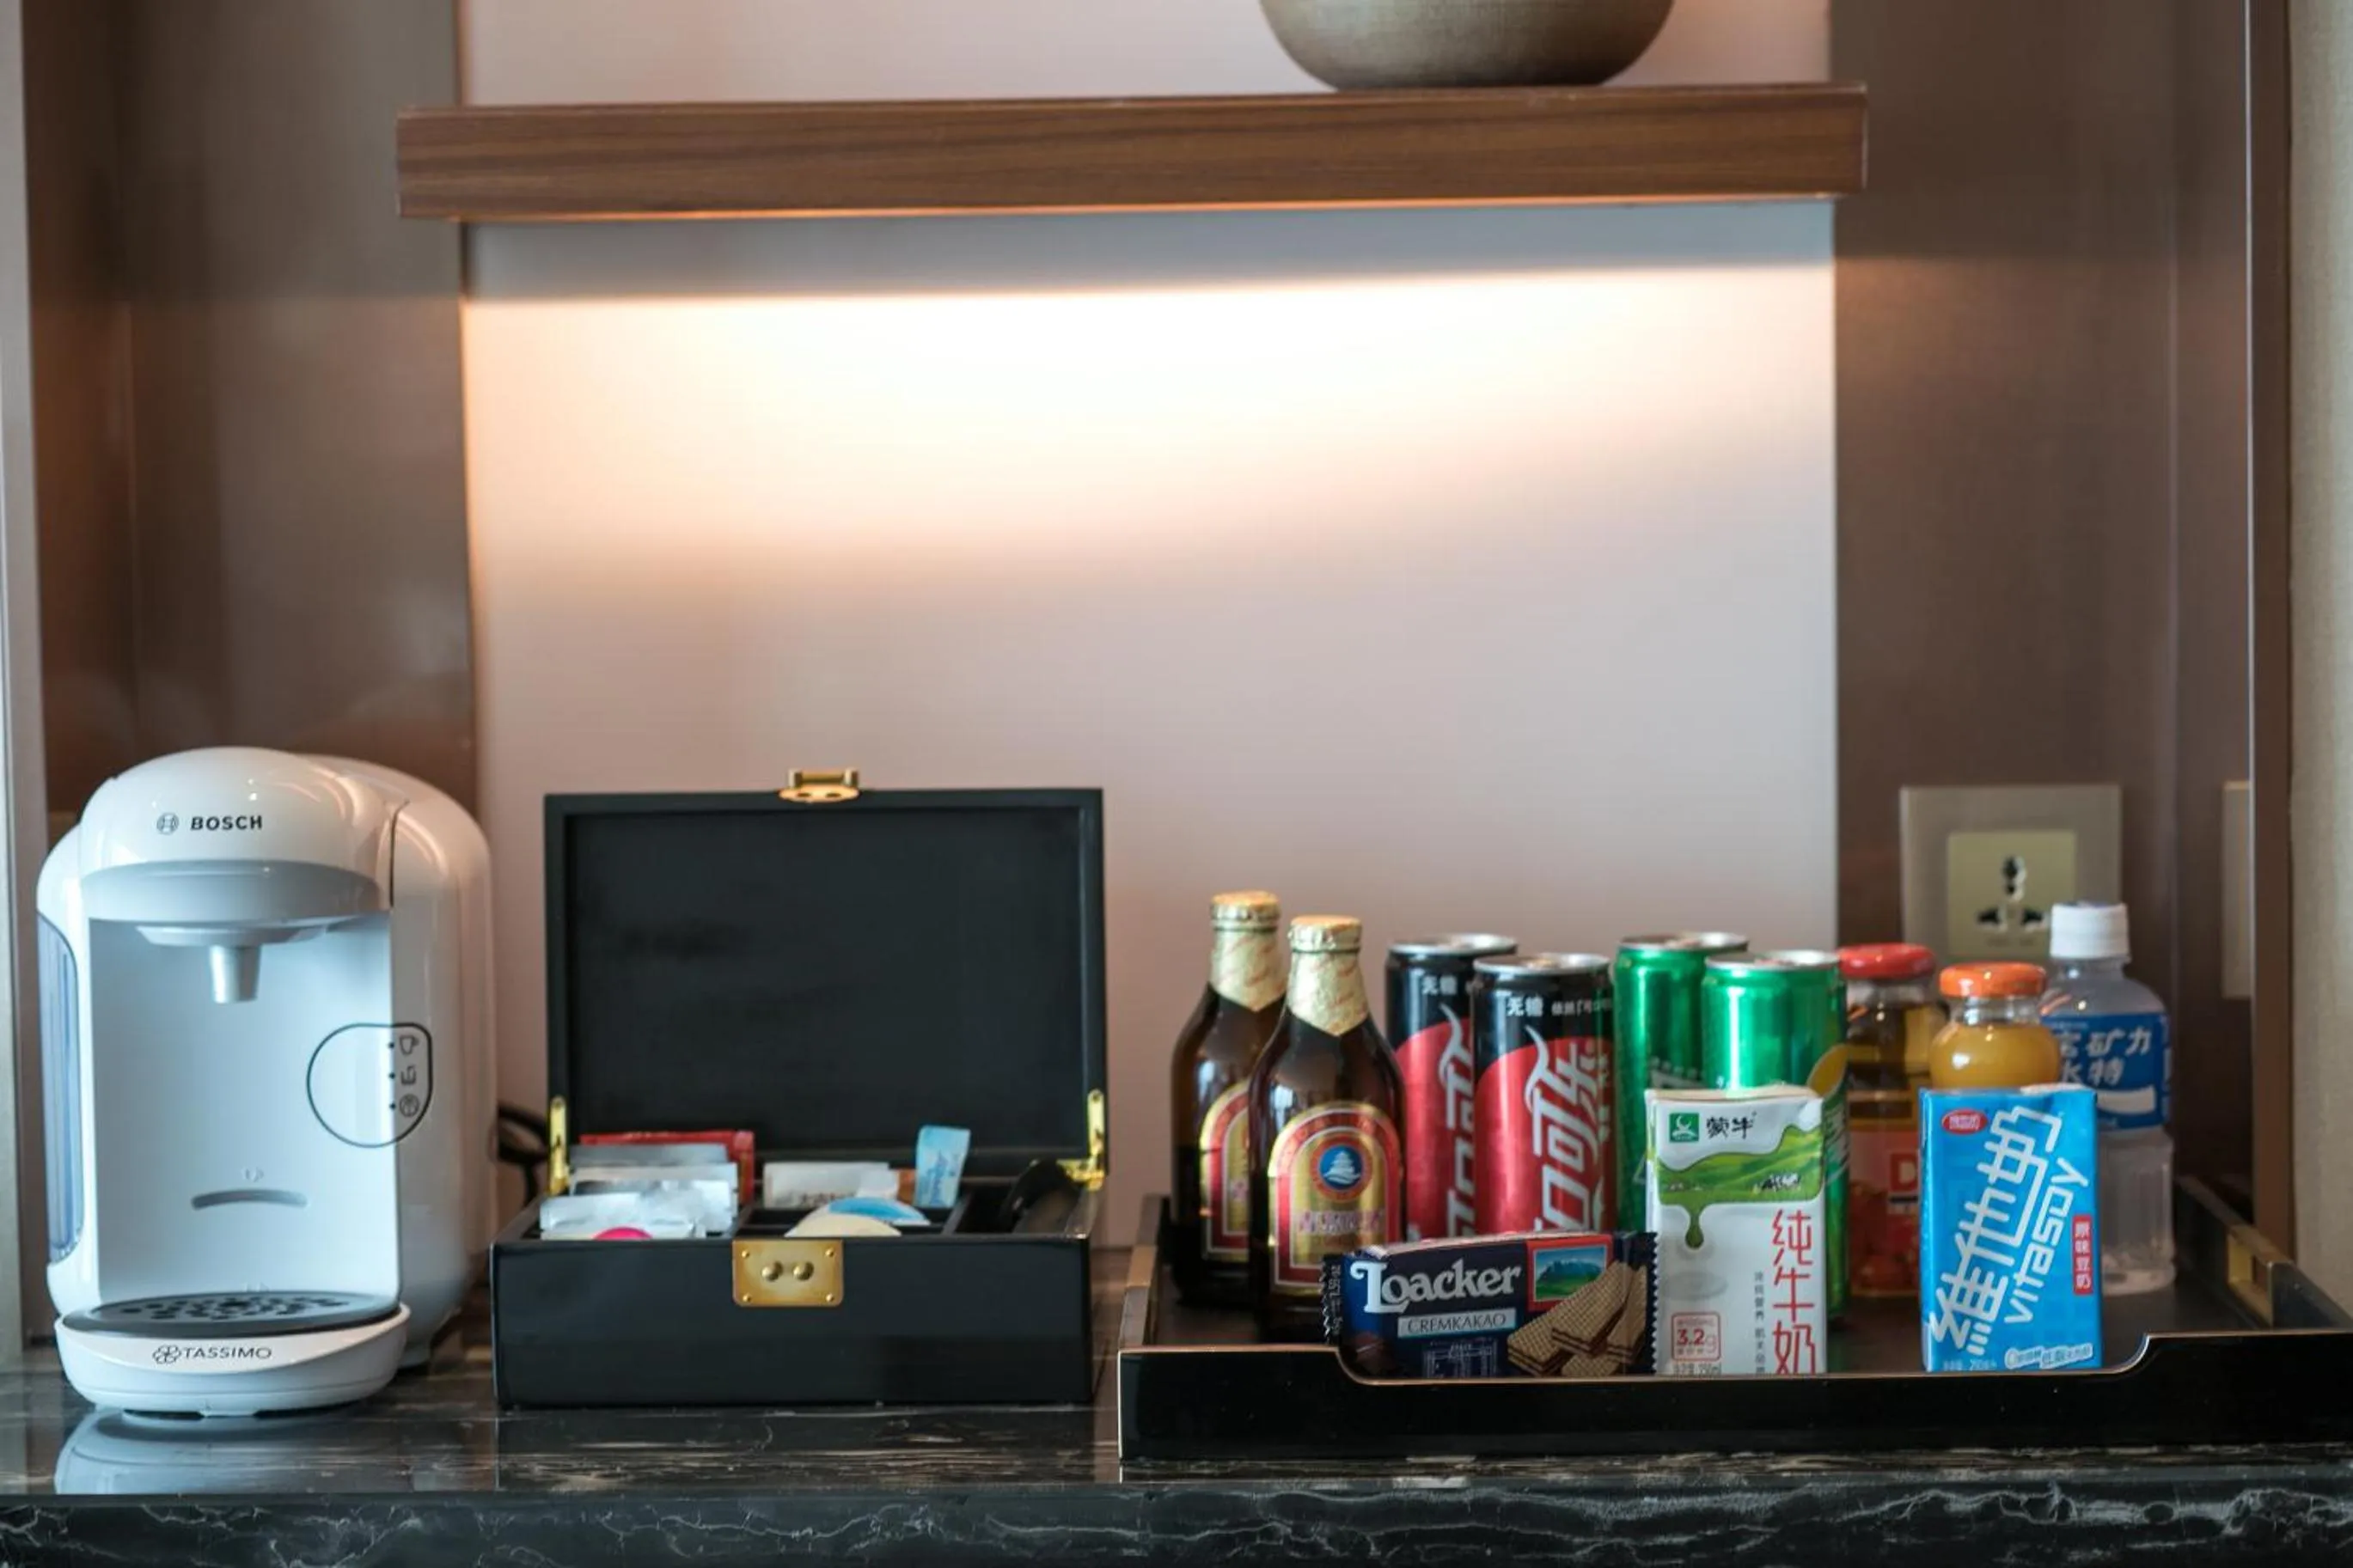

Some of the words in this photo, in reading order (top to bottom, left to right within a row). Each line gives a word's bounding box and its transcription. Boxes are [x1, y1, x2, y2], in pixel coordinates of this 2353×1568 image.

[191, 815, 262, 831] BOSCH
[1705, 1116, 1754, 1139] 蒙牛
[1349, 1259, 1522, 1314] Loacker
[1772, 1208, 1816, 1375] 纯牛奶
[1407, 1313, 1507, 1333] CREMKAKAO
[184, 1346, 272, 1359] TASSIMO
